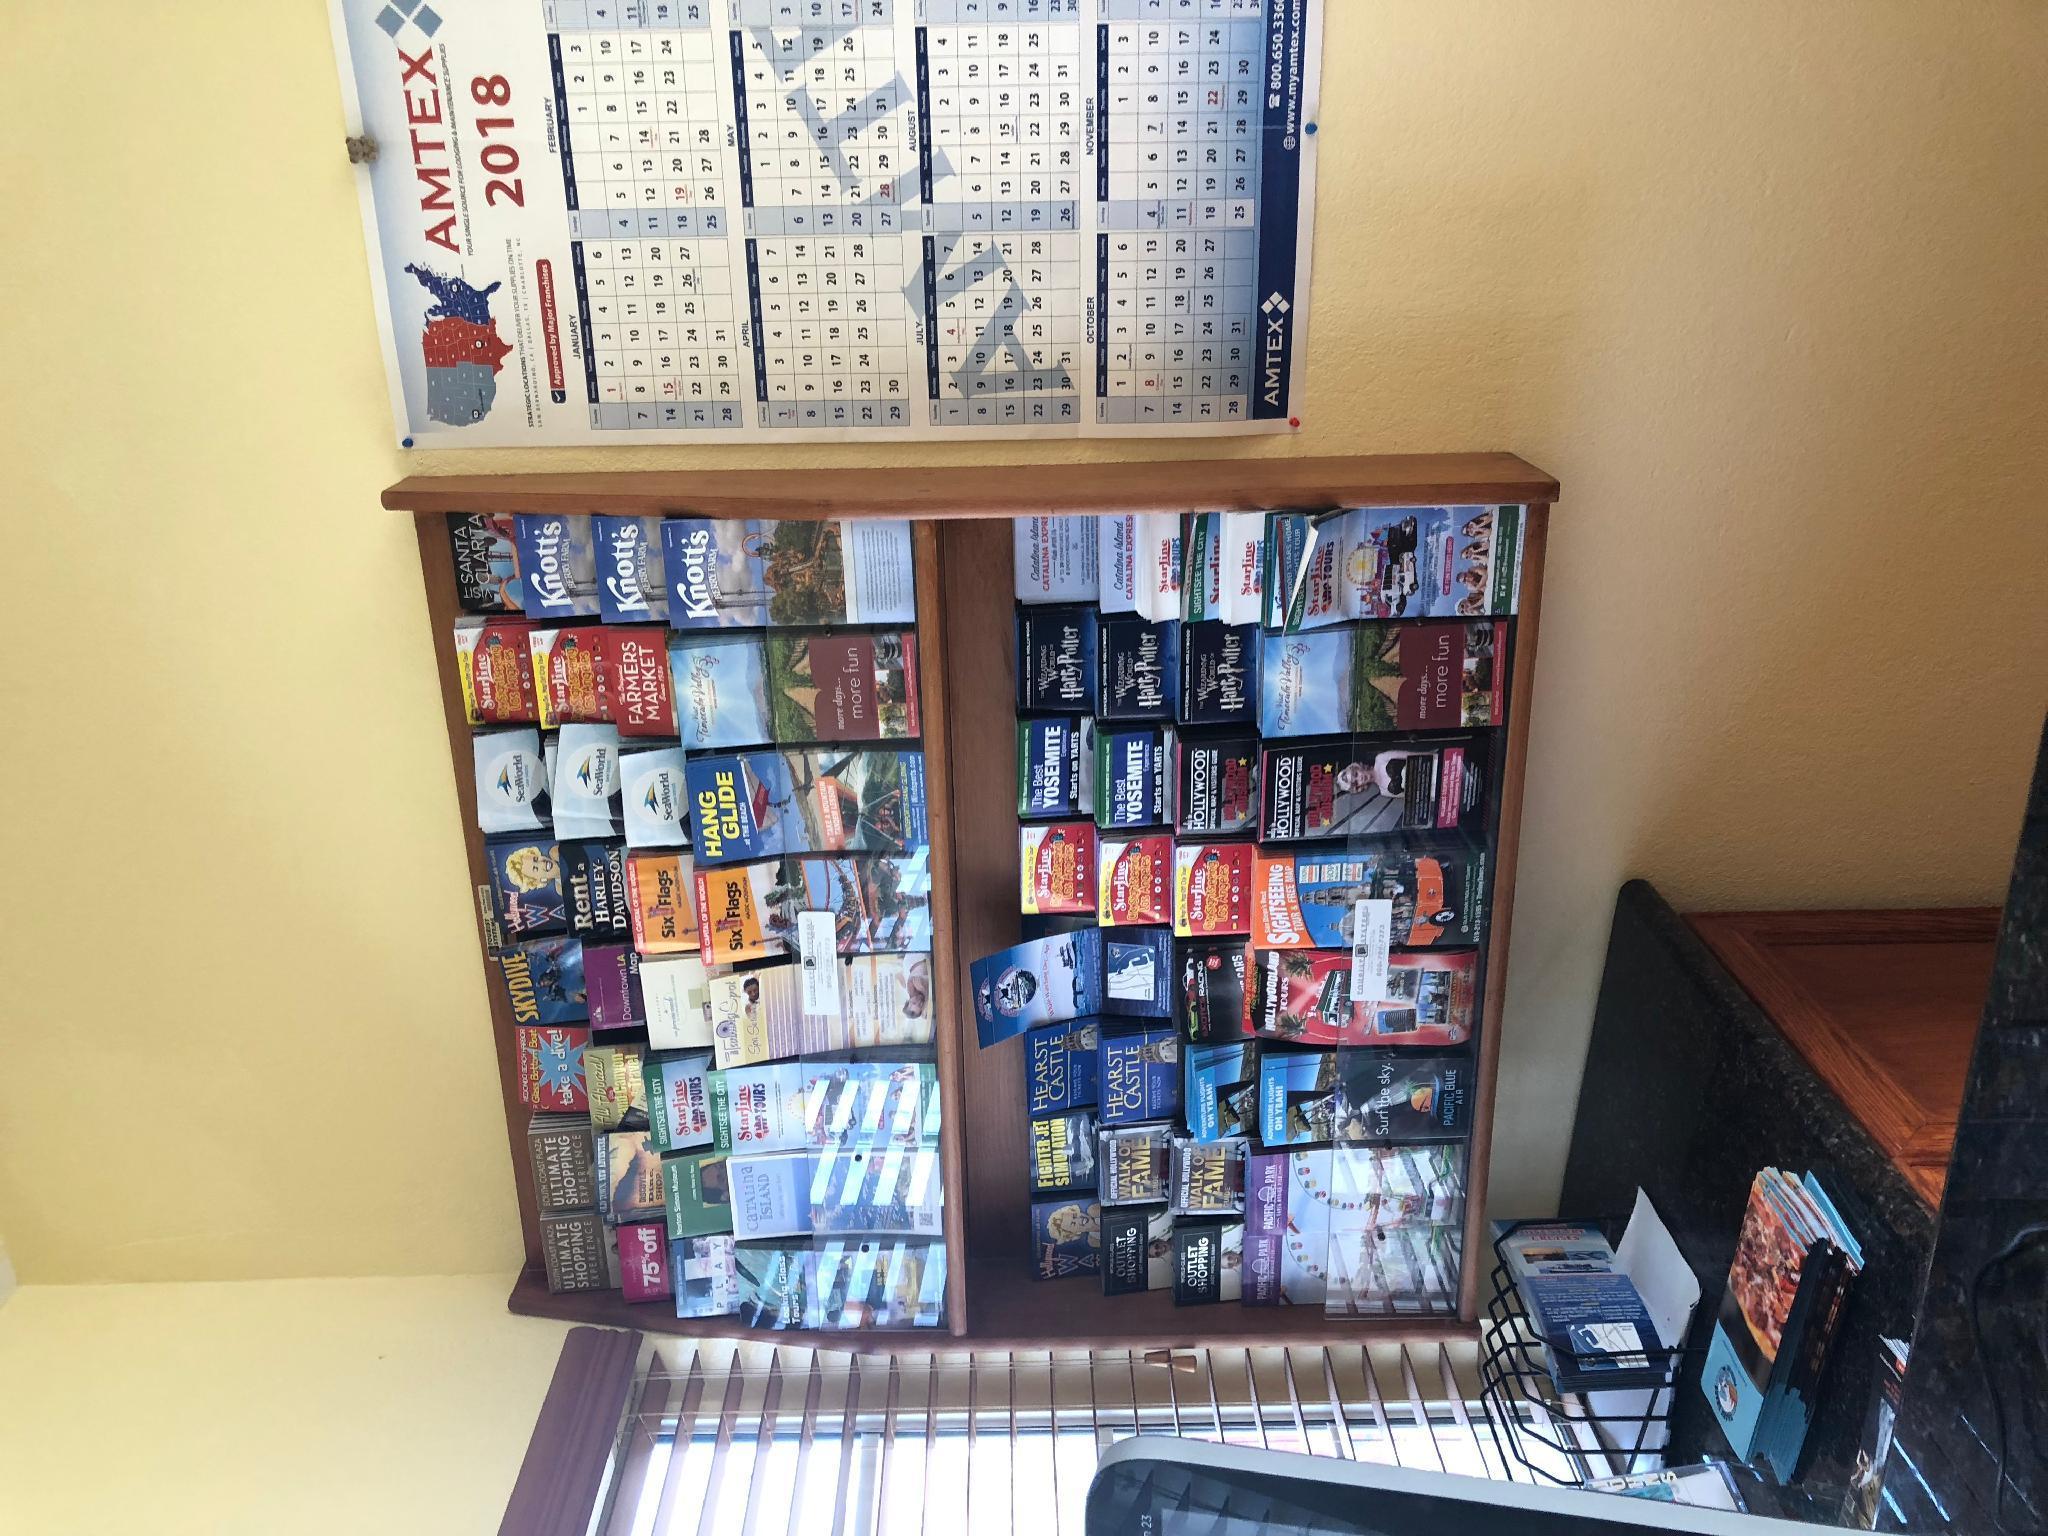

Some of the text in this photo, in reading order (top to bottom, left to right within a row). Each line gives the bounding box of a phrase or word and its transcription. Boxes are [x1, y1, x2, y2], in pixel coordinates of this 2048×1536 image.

[1286, 0, 1300, 135] www.myamtex.com
[397, 47, 460, 255] AMTEX
[471, 74, 524, 207] 2018
[544, 98, 558, 154] FEBRUARY
[726, 124, 736, 147] MAY
[906, 109, 918, 152] AUGUST
[1084, 98, 1095, 156] NOVEMBER
[620, 247, 632, 261] 13
[624, 275, 636, 289] 12
[540, 264, 562, 385] Approved by Major Franchises
[568, 314, 582, 359] JANUARY
[626, 303, 638, 316] 11
[629, 329, 641, 343] 10
[741, 320, 751, 348] APRIL
[914, 321, 925, 346] JULY
[1085, 297, 1096, 344] OCTOBER
[632, 359, 643, 367] 9
[1262, 318, 1285, 407] AMTEX
[454, 526, 474, 584] SANTA
[468, 513, 490, 585] CLARITA
[530, 522, 575, 608] Knott's
[606, 524, 650, 613] Knott's
[676, 530, 720, 620] Knott's
[1041, 546, 1050, 591] CATALINA
[1113, 552, 1124, 590] Catalina
[1125, 553, 1133, 600] CATALINA
[1158, 538, 1171, 593] Starline
[1241, 541, 1255, 595] Starline
[1324, 541, 1334, 579] TOURS
[1307, 545, 1324, 616] Starline
[475, 654, 494, 709] Starline
[504, 649, 521, 711] Los Angeles
[551, 655, 569, 713] Starline
[622, 641, 644, 724] FARMERS
[639, 645, 661, 720] MARKET
[843, 647, 864, 719] more fun
[1057, 625, 1089, 700] Harry Potter
[1134, 632, 1167, 708] Harry Potter
[1216, 634, 1248, 712] Harry Potter
[1277, 652, 1294, 683] Valley
[1417, 665, 1430, 719] more days...
[1432, 634, 1450, 708] more fun
[835, 707, 845, 730] more
[513, 754, 525, 802] SeaWorld
[592, 747, 607, 796] SeaWorld
[1032, 764, 1043, 807] The Best
[1043, 726, 1061, 808] YOSEMITE
[1069, 731, 1079, 799] Starts on YARTS
[1127, 740, 1143, 823] YOSEMITE
[1153, 745, 1163, 813] Starts on YARTS
[1193, 749, 1206, 830] HOLLYWOOD
[659, 772, 673, 821] SeaWorld
[698, 790, 723, 857] HANG
[715, 771, 741, 839] GLIDE
[738, 802, 749, 823] BEACH
[1114, 779, 1126, 821] The Best
[1277, 755, 1292, 838] HOLLYWOOD
[570, 873, 594, 930] Rent
[593, 858, 610, 923] HARLEY-
[609, 850, 627, 929] DAVIDSON
[656, 870, 675, 938] Six Flags
[1038, 848, 1051, 899] Starline
[1113, 860, 1129, 911] Starline
[1190, 868, 1205, 920] Starline
[1266, 864, 1300, 944] SIGHTSEEING
[1285, 865, 1304, 932] TOUR FREE MAP
[726, 881, 744, 951] Six Flags
[501, 951, 540, 1023] SKYDIVE
[617, 954, 632, 1020] Downtown LA
[629, 952, 639, 974] Map
[1197, 960, 1205, 997] RACING
[1265, 952, 1280, 1031] HOLLYWOODLAND
[1279, 977, 1289, 1011] TOURS
[529, 1029, 540, 1103] Glass Bottom Boat
[547, 1029, 575, 1105] take a dive!
[589, 1055, 611, 1124] All Aboard!
[1033, 1038, 1049, 1111] HEARST
[1048, 1034, 1065, 1101] CASTLE
[1107, 1046, 1124, 1118] HEARST
[1124, 1045, 1142, 1109] CASTLE
[1454, 1088, 1464, 1105] AIR
[652, 1078, 668, 1145] SIGHTSEE THE CITY
[716, 1080, 730, 1149] SIGHTSEE CITY
[753, 1083, 767, 1113] TOURS
[1274, 1086, 1284, 1131] OH YEAH!
[1375, 1062, 1395, 1135] Surf the sky.
[1443, 1069, 1456, 1126] PACIFIC BLUE
[544, 1136, 565, 1206] ULTIMATE
[557, 1135, 579, 1205] SHOPPING
[573, 1135, 590, 1204] EXPERIENCE
[1050, 1118, 1070, 1185] SIMULATION
[1118, 1140, 1131, 1199] WALK OF
[1131, 1136, 1150, 1199] FAME
[1203, 1146, 1225, 1208] FAME
[758, 1173, 774, 1220] ISLAND
[1190, 1169, 1203, 1209] WALK
[1262, 1165, 1276, 1230] PACIFIC PARK
[555, 1223, 576, 1289] ULTIMATE
[569, 1221, 589, 1288] SHOPPING
[714, 1243, 724, 1309] PLAY
[1116, 1236, 1127, 1277] OUTLET
[1126, 1227, 1137, 1283] SHOPPING
[1187, 1246, 1198, 1286] OUTLET
[1197, 1237, 1209, 1292] SHOPPING
[1256, 1239, 1269, 1300] PACIFIC PARK
[778, 1255, 792, 1324] Looking Glass
[790, 1294, 800, 1324] Tours
[1141, 1514, 1152, 1528] 23
